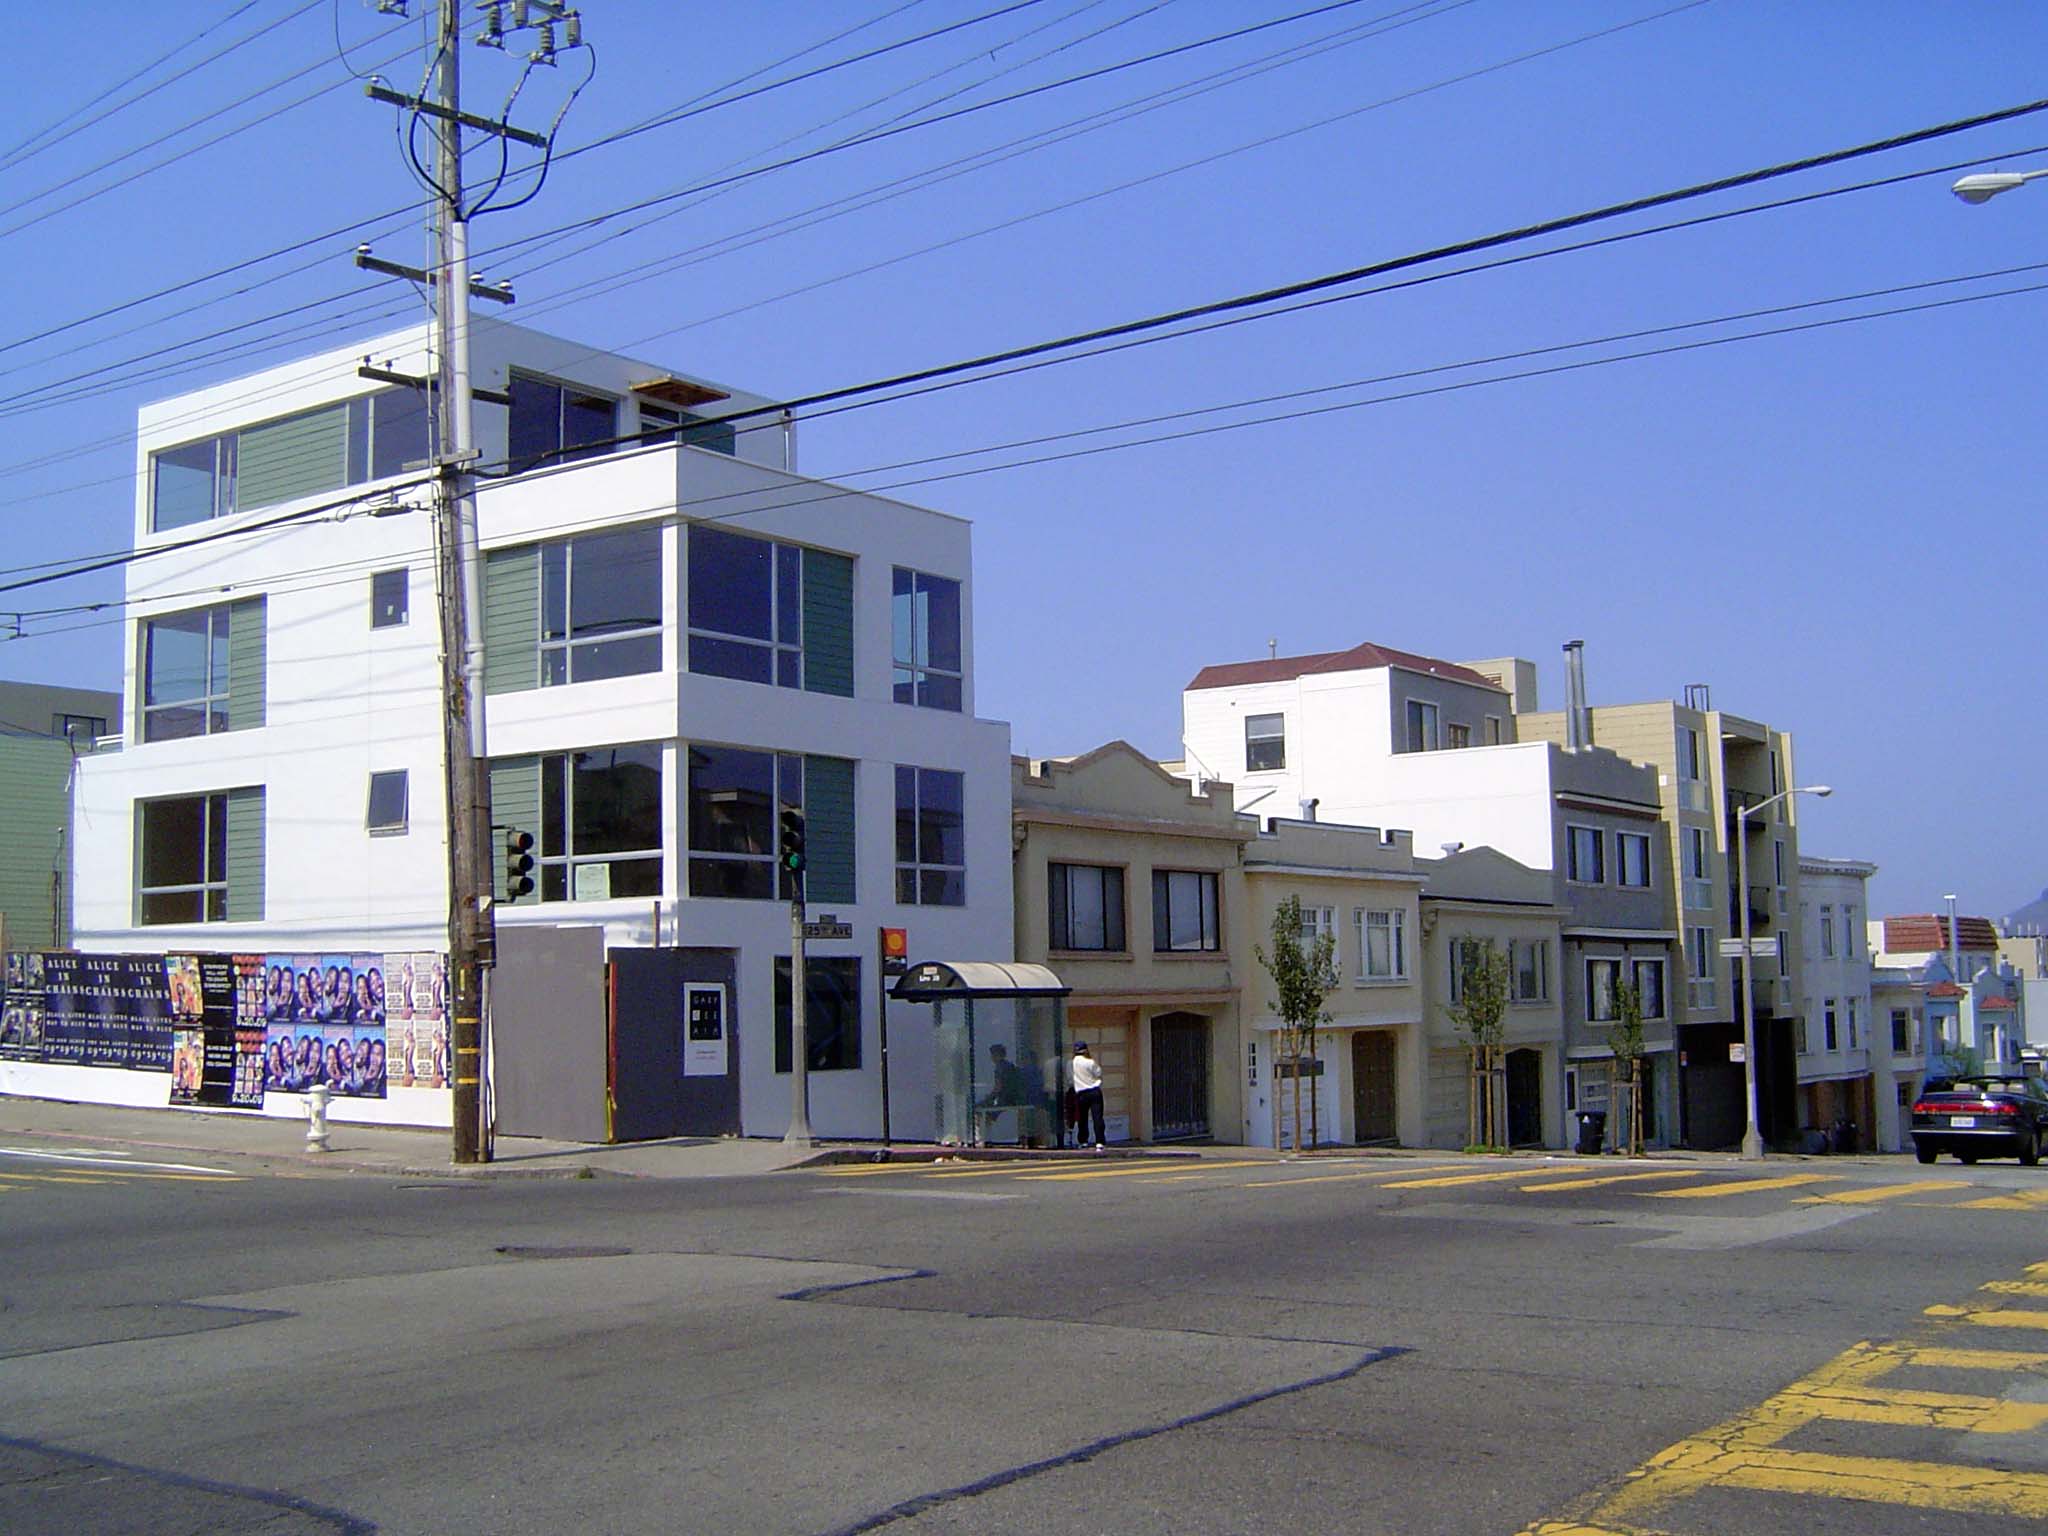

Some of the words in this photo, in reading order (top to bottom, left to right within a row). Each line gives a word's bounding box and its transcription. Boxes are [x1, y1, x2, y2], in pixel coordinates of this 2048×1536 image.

[832, 926, 850, 936] AVE
[47, 959, 78, 969] ALICE
[88, 961, 120, 971] ALICE
[128, 962, 162, 973] ALICE
[58, 972, 70, 981] IN
[98, 974, 110, 984] IN
[140, 976, 152, 985] IN
[46, 985, 85, 995] CHAINS
[86, 986, 126, 997] CHAINS
[128, 989, 170, 999] CHAINS
